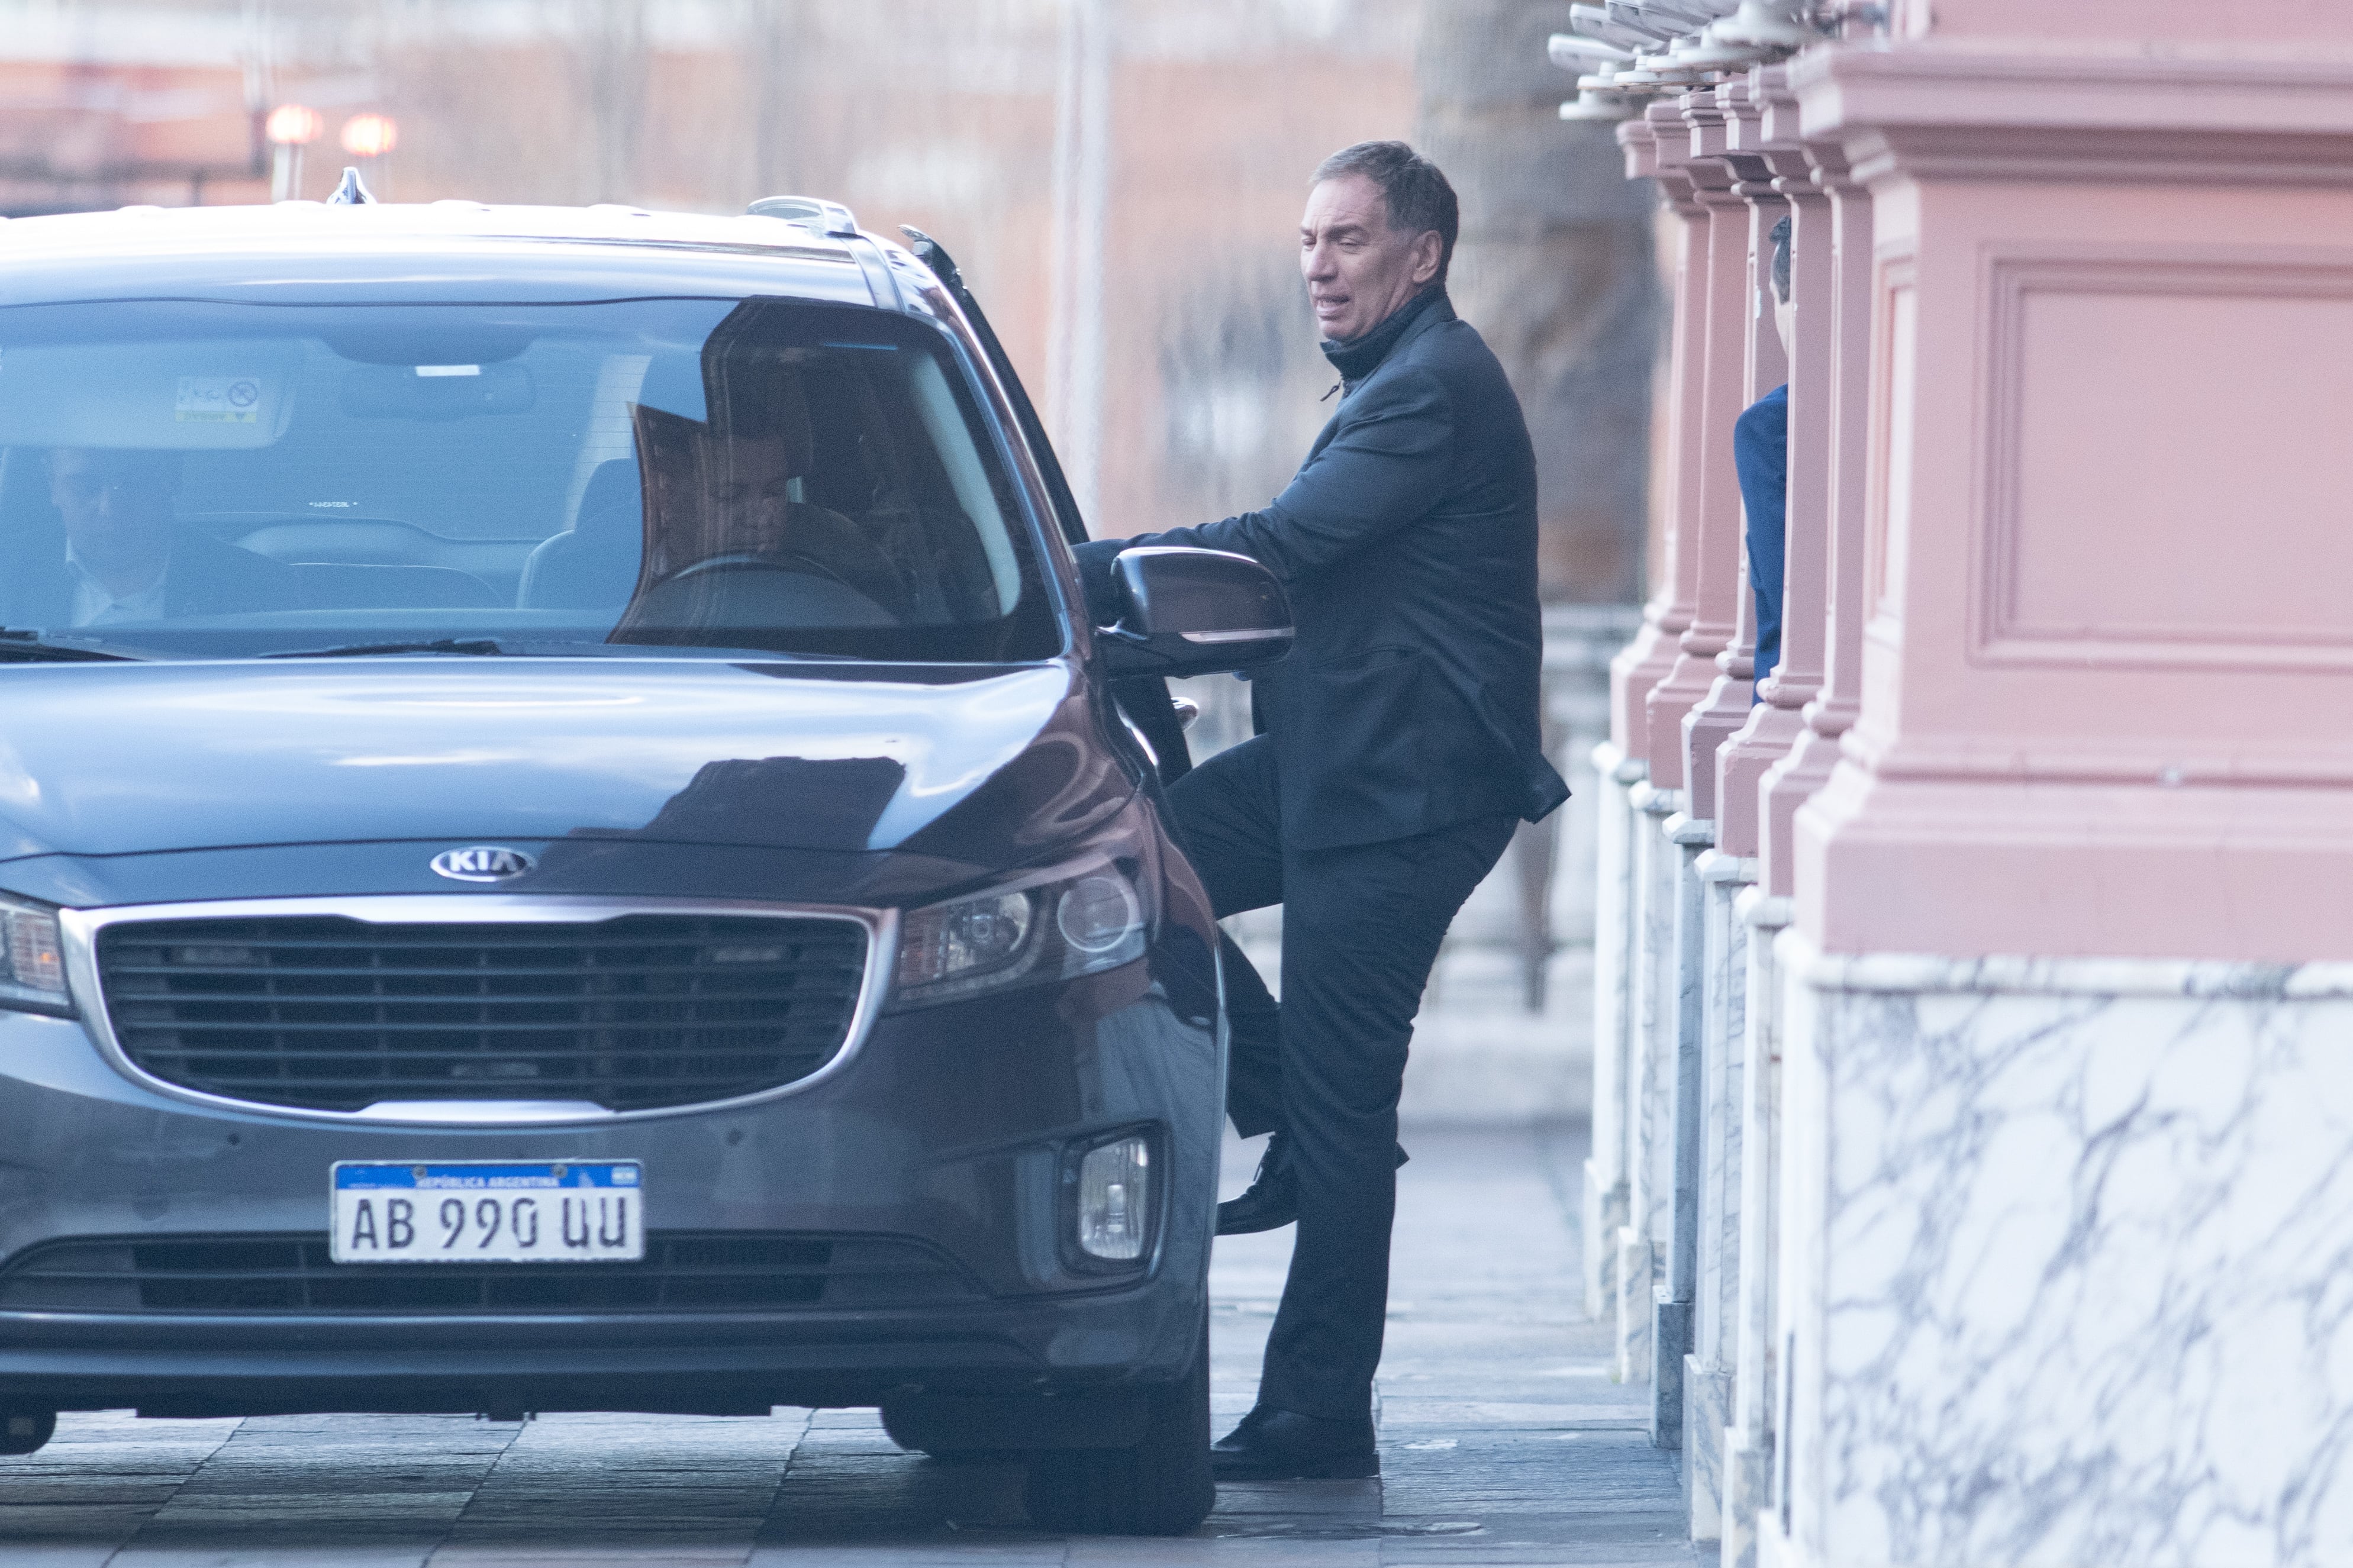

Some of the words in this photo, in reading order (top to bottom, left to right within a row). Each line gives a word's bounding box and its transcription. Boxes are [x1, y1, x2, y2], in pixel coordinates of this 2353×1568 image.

[449, 850, 517, 872] KIA
[351, 1198, 414, 1249] AB
[439, 1198, 537, 1249] 990
[562, 1197, 626, 1248] UU
